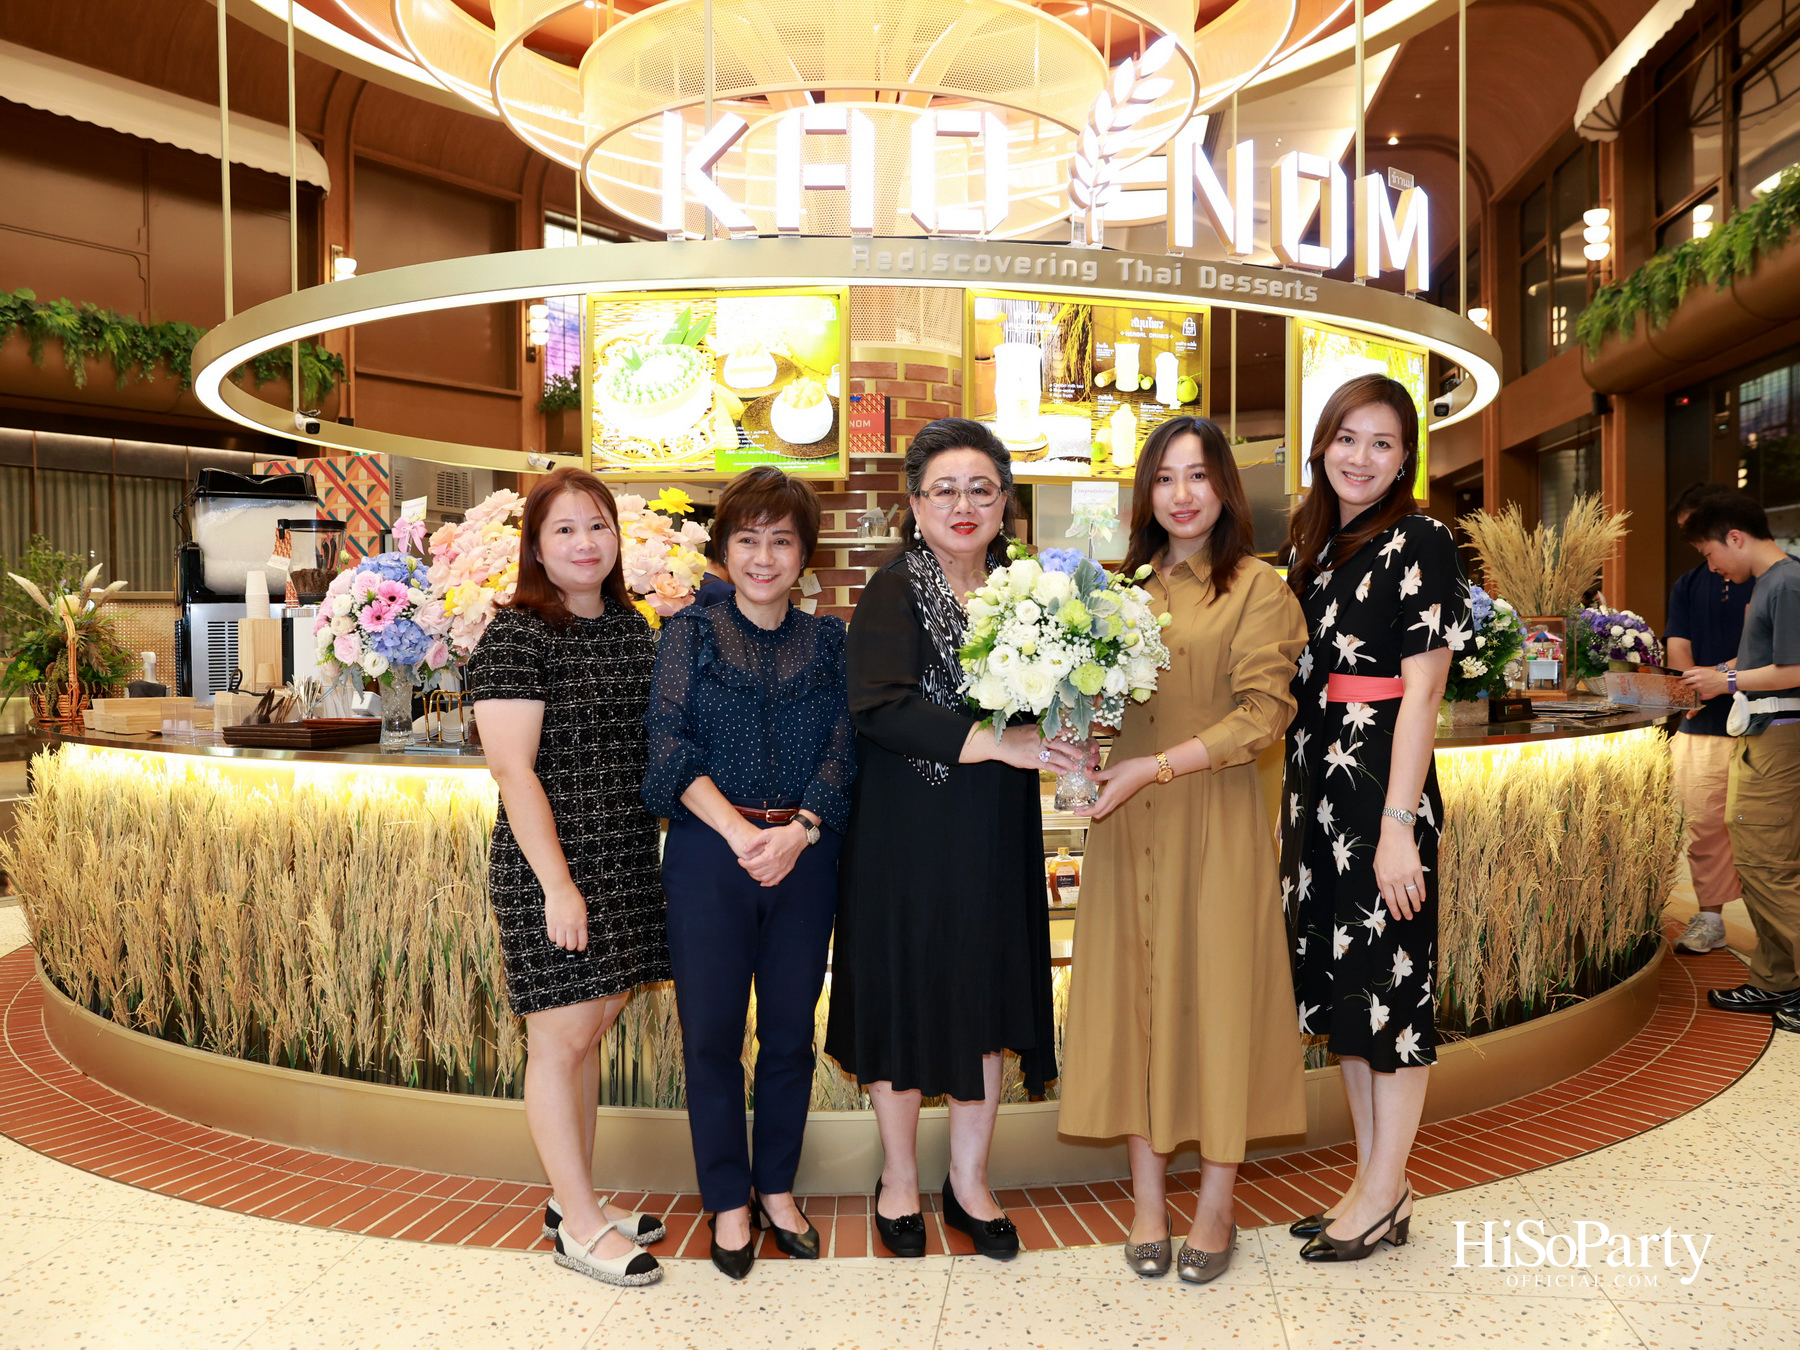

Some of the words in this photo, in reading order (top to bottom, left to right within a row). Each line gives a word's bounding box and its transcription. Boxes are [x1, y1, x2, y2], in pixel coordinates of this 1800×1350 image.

[1166, 138, 1430, 293] NOM
[851, 243, 1098, 282] Rediscovering
[1117, 257, 1182, 286] Thai
[1200, 265, 1319, 303] Desserts
[849, 419, 871, 428] NOM
